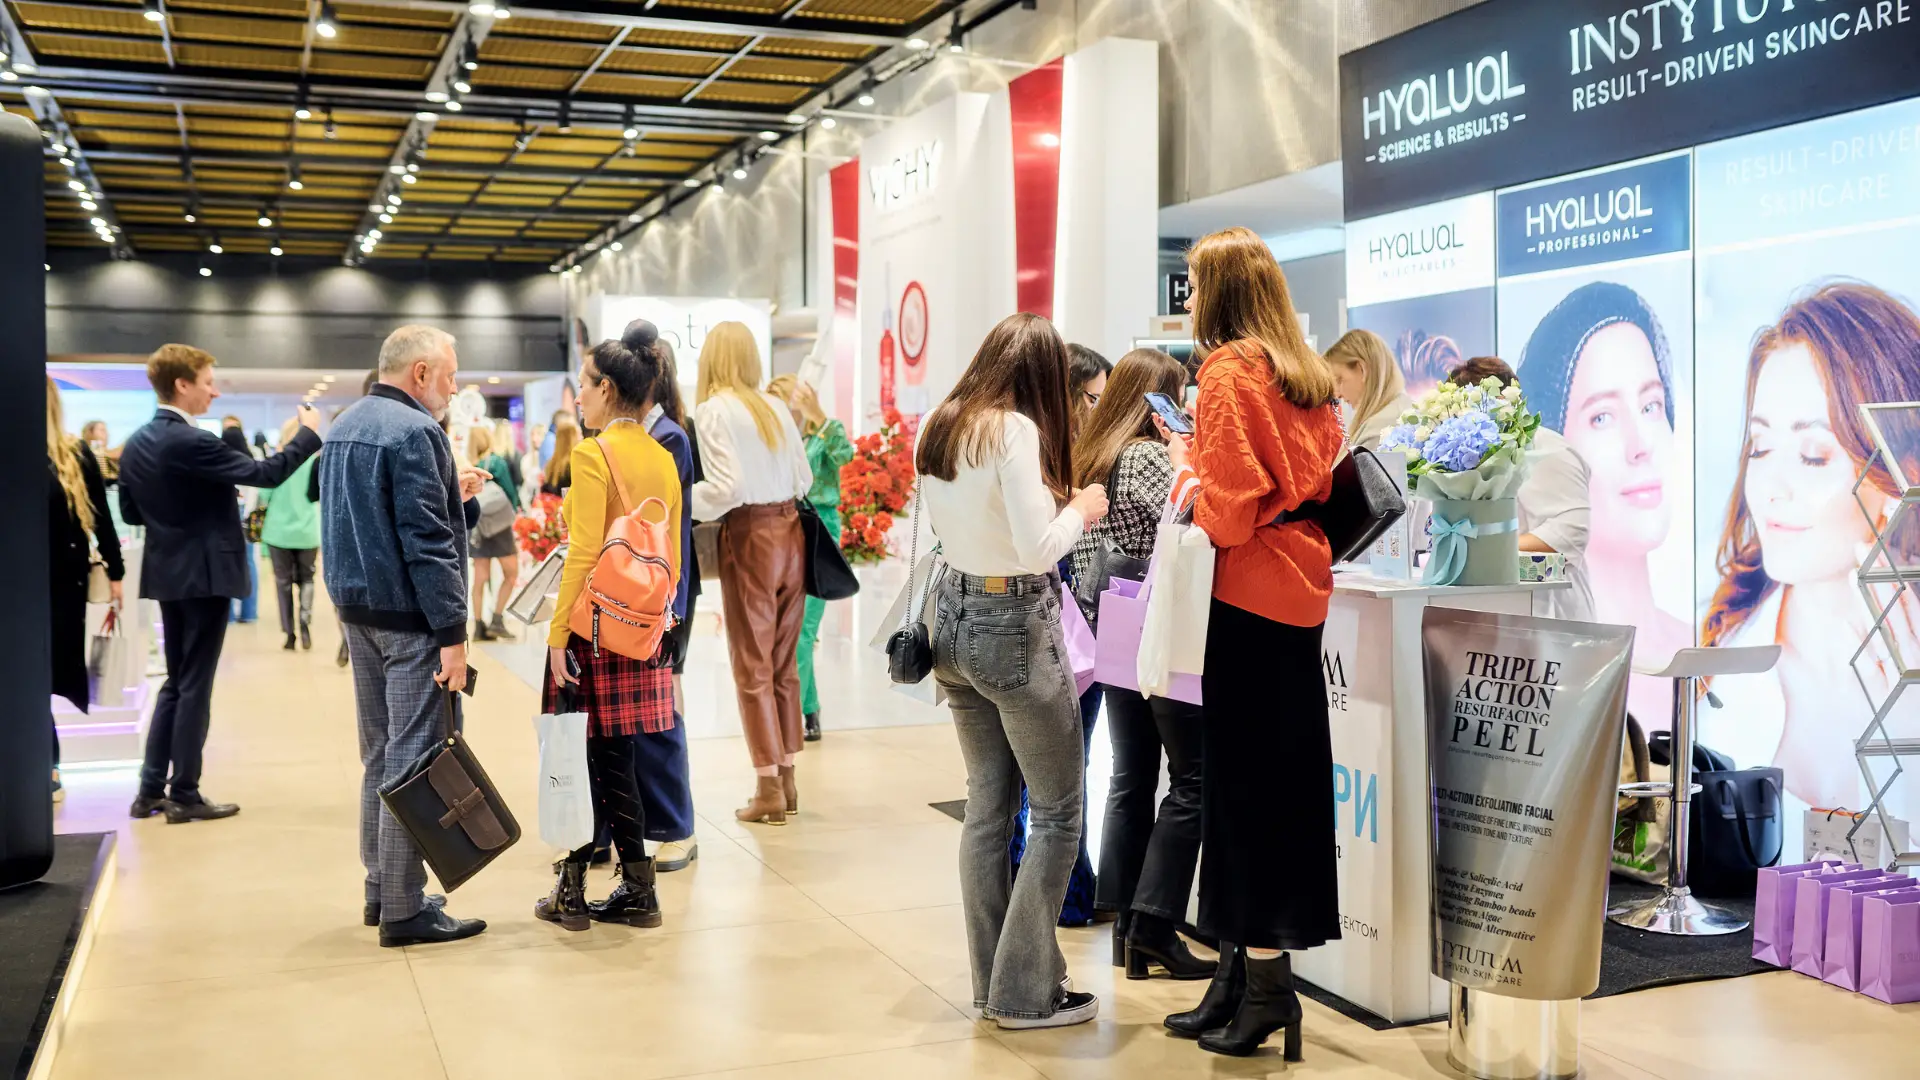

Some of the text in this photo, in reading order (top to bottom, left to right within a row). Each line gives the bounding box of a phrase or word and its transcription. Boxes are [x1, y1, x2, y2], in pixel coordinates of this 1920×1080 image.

[1572, 0, 1912, 112] RESULT-DRIVEN SKINCARE
[1378, 111, 1509, 164] SCIENCE & RESULTS
[1759, 172, 1891, 219] SKINCARE
[1538, 226, 1639, 255] PROFESSIONAL
[1466, 651, 1562, 687] TRIPLE
[1455, 677, 1555, 710] ACTION
[1454, 700, 1550, 728] RESURFACING
[1450, 715, 1546, 758] PEEL
[1333, 762, 1378, 844] РИ
[1475, 794, 1523, 815] EXFOLIATING
[1525, 805, 1555, 822] FACIAL
[1508, 833, 1534, 846] TEXTURE
[1522, 823, 1553, 837] WRINKLES
[1469, 872, 1502, 888] Salicylic
[1502, 880, 1524, 893] Acid
[1470, 883, 1505, 900] Enzymes
[1473, 897, 1507, 913] Bamboo
[1508, 904, 1537, 919] beads
[1478, 911, 1503, 925] Algae
[1338, 913, 1379, 941] ЕКТОМ
[1455, 913, 1483, 931] Retinol
[1483, 922, 1536, 943] Alternative
[1472, 969, 1523, 987] SKINCARE
